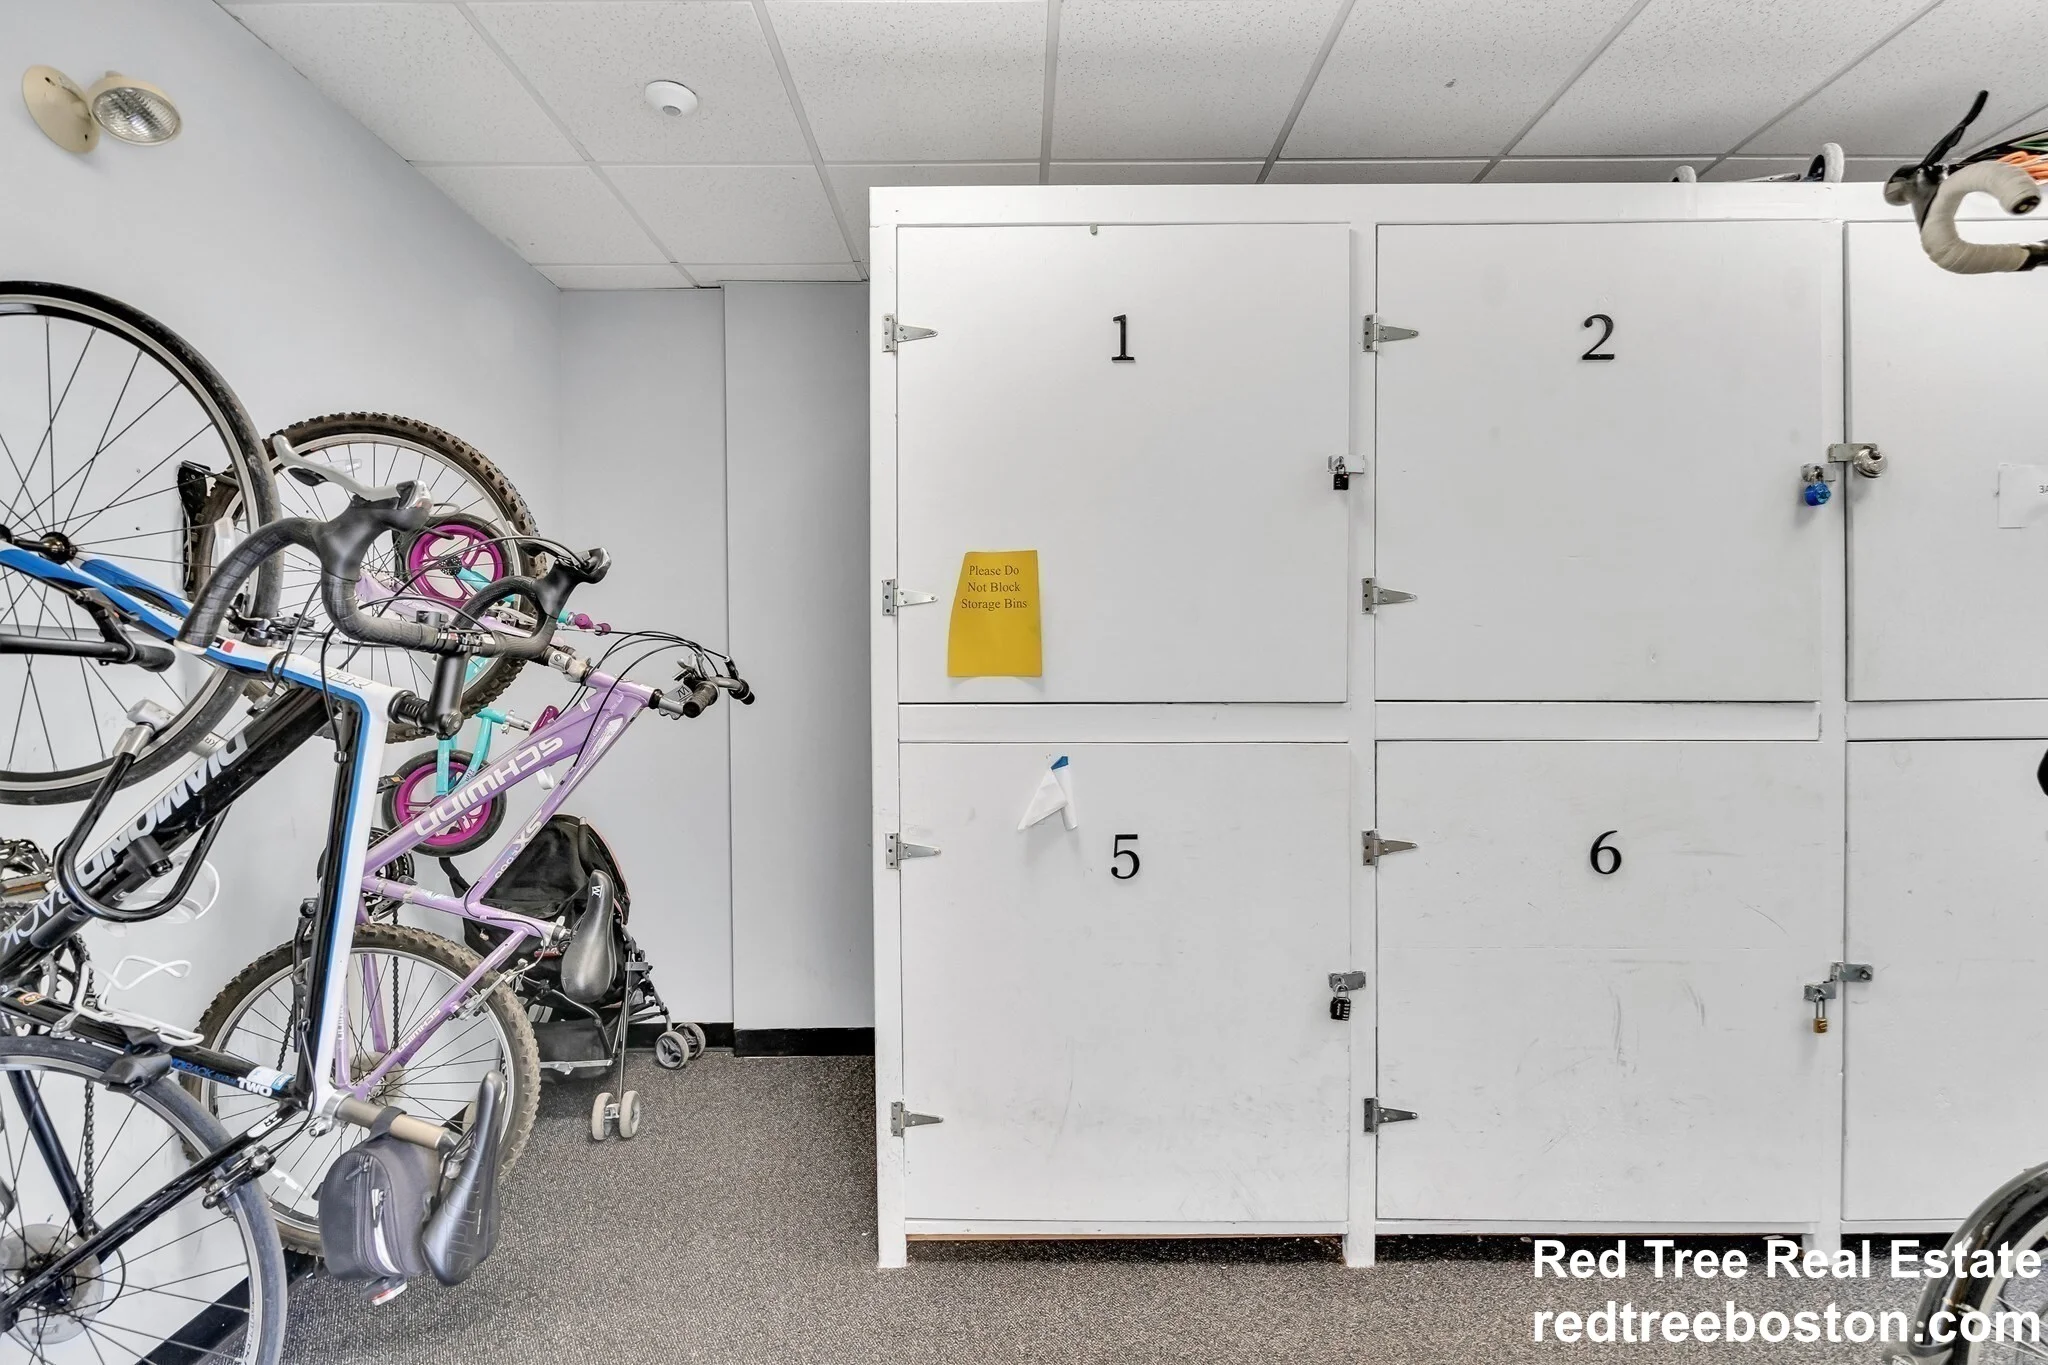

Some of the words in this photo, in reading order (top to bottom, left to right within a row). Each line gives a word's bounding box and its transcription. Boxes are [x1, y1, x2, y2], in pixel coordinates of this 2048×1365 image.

[1111, 314, 1136, 362] 1
[1581, 313, 1616, 361] 2
[967, 581, 987, 593] Not
[990, 581, 1021, 593] Block
[968, 564, 1002, 576] Please
[1004, 564, 1020, 576] Do
[960, 598, 1001, 612] Storage
[1004, 598, 1028, 610] Bins
[414, 736, 564, 836] SCHWINN
[1111, 833, 1142, 880] 5
[1590, 830, 1622, 875] 6
[397, 1008, 442, 1053] SCHWINN
[237, 1076, 274, 1098] TWO
